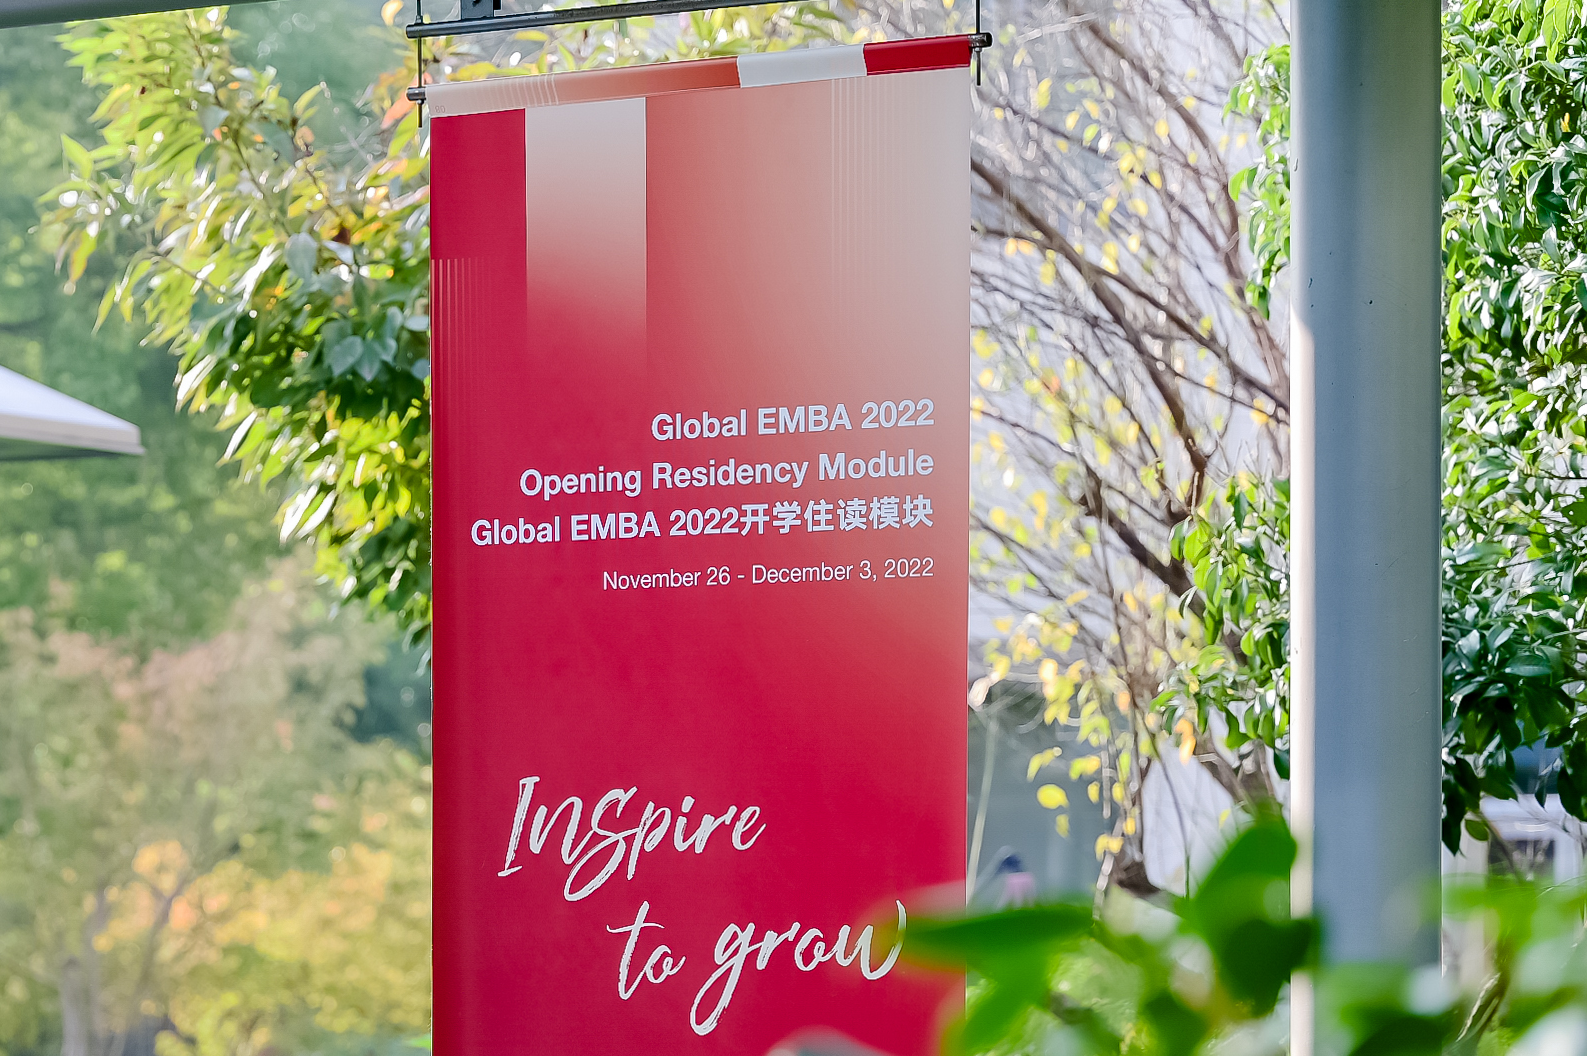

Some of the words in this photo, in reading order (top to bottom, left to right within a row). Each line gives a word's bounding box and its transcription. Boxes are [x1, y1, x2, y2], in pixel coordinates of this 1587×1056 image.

[650, 408, 747, 442] Global
[757, 403, 853, 437] EMBA
[860, 397, 936, 430] 2022
[519, 464, 642, 501] Opening
[652, 457, 809, 492] Residency
[818, 448, 935, 481] Module
[470, 515, 562, 546] Global
[570, 510, 662, 541] EMBA
[668, 494, 934, 537] 2022开学住读模块
[602, 568, 702, 591] November
[706, 565, 732, 586] 26
[751, 561, 854, 585] December
[859, 559, 878, 583] 3,
[884, 557, 935, 579] 2022
[606, 900, 687, 1001] to
[689, 899, 907, 1036] grow
